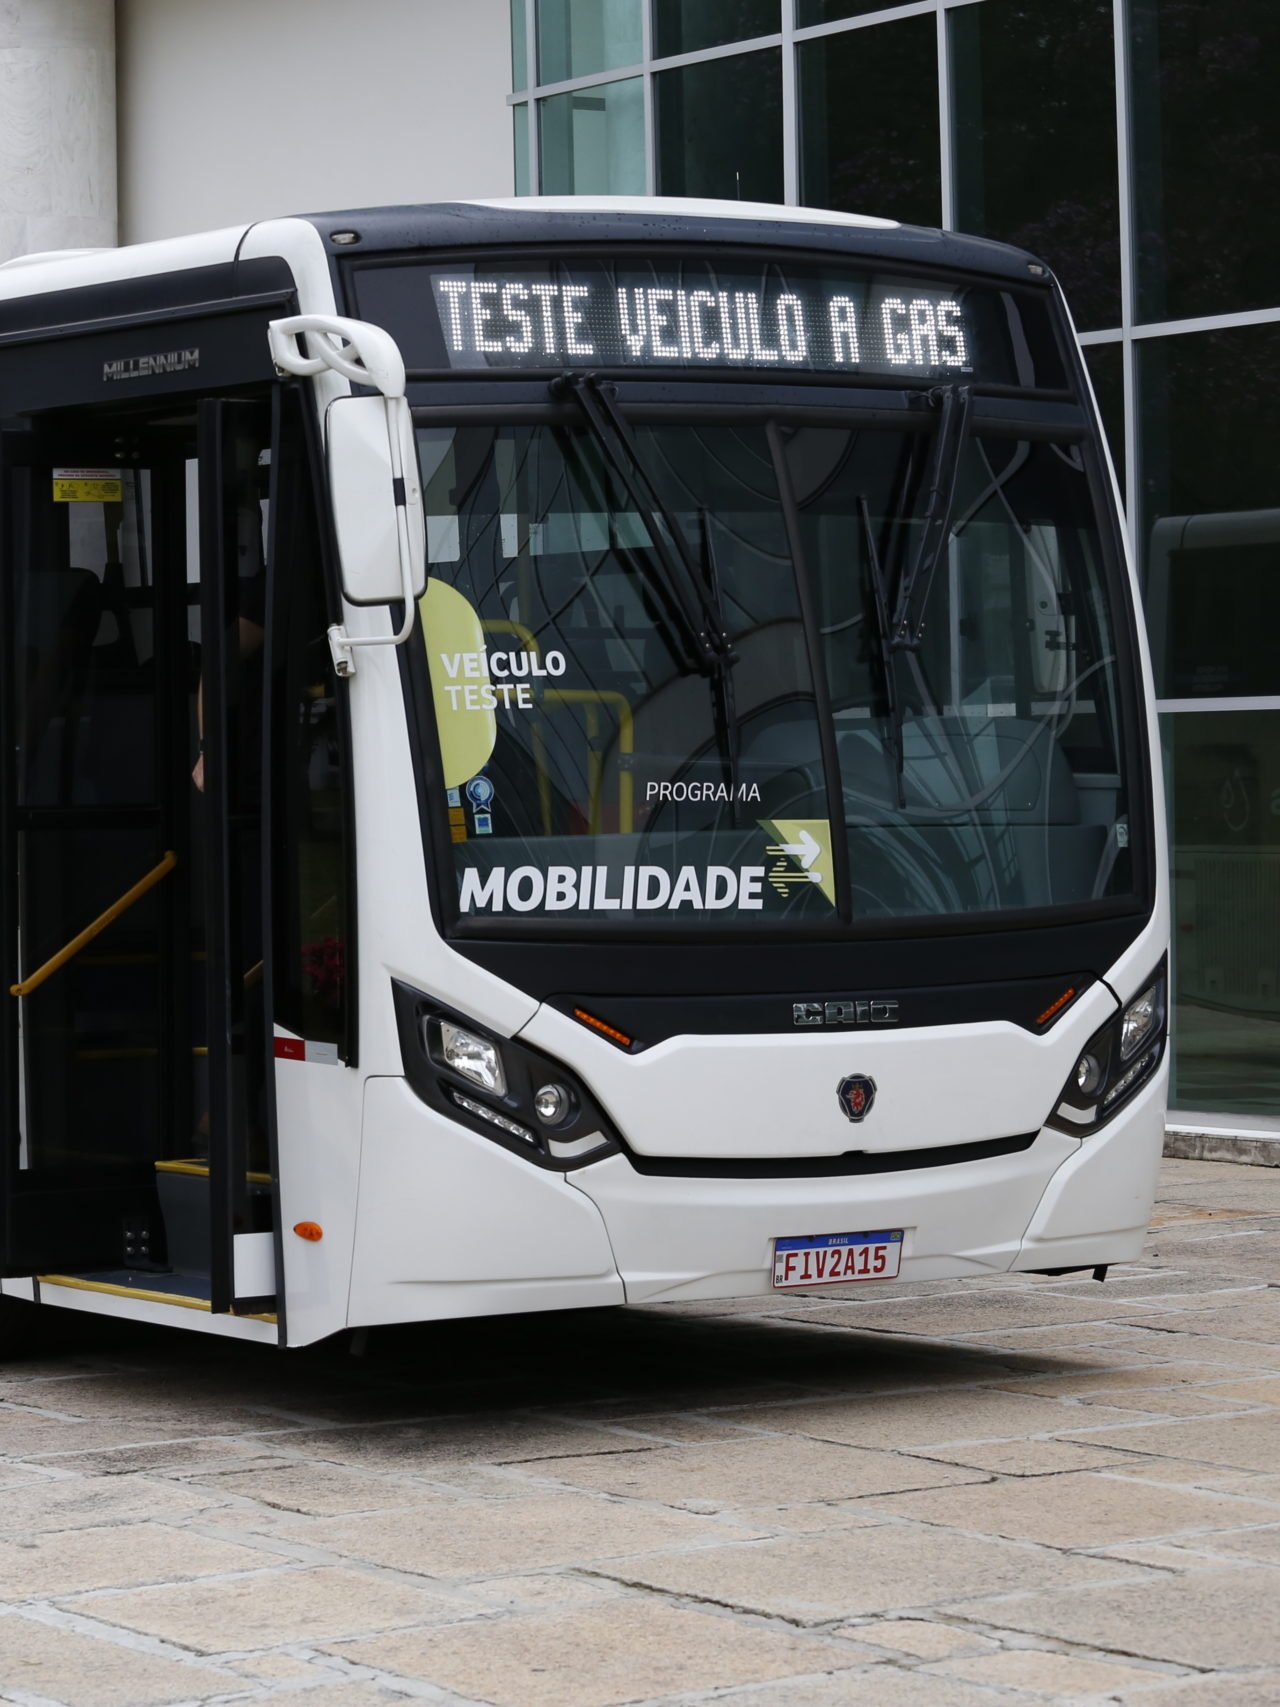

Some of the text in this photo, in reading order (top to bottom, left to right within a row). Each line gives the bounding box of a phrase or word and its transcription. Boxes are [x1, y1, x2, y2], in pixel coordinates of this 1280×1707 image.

[439, 280, 968, 366] TESTE VEICULO A GAS
[103, 347, 199, 382] MILLENNIUM
[440, 644, 566, 678] VEÍCULO
[444, 683, 533, 711] TESTE
[645, 782, 761, 802] PROGRAMA
[459, 865, 766, 913] MOBILIDADE
[784, 1246, 887, 1281] FIV2A15
